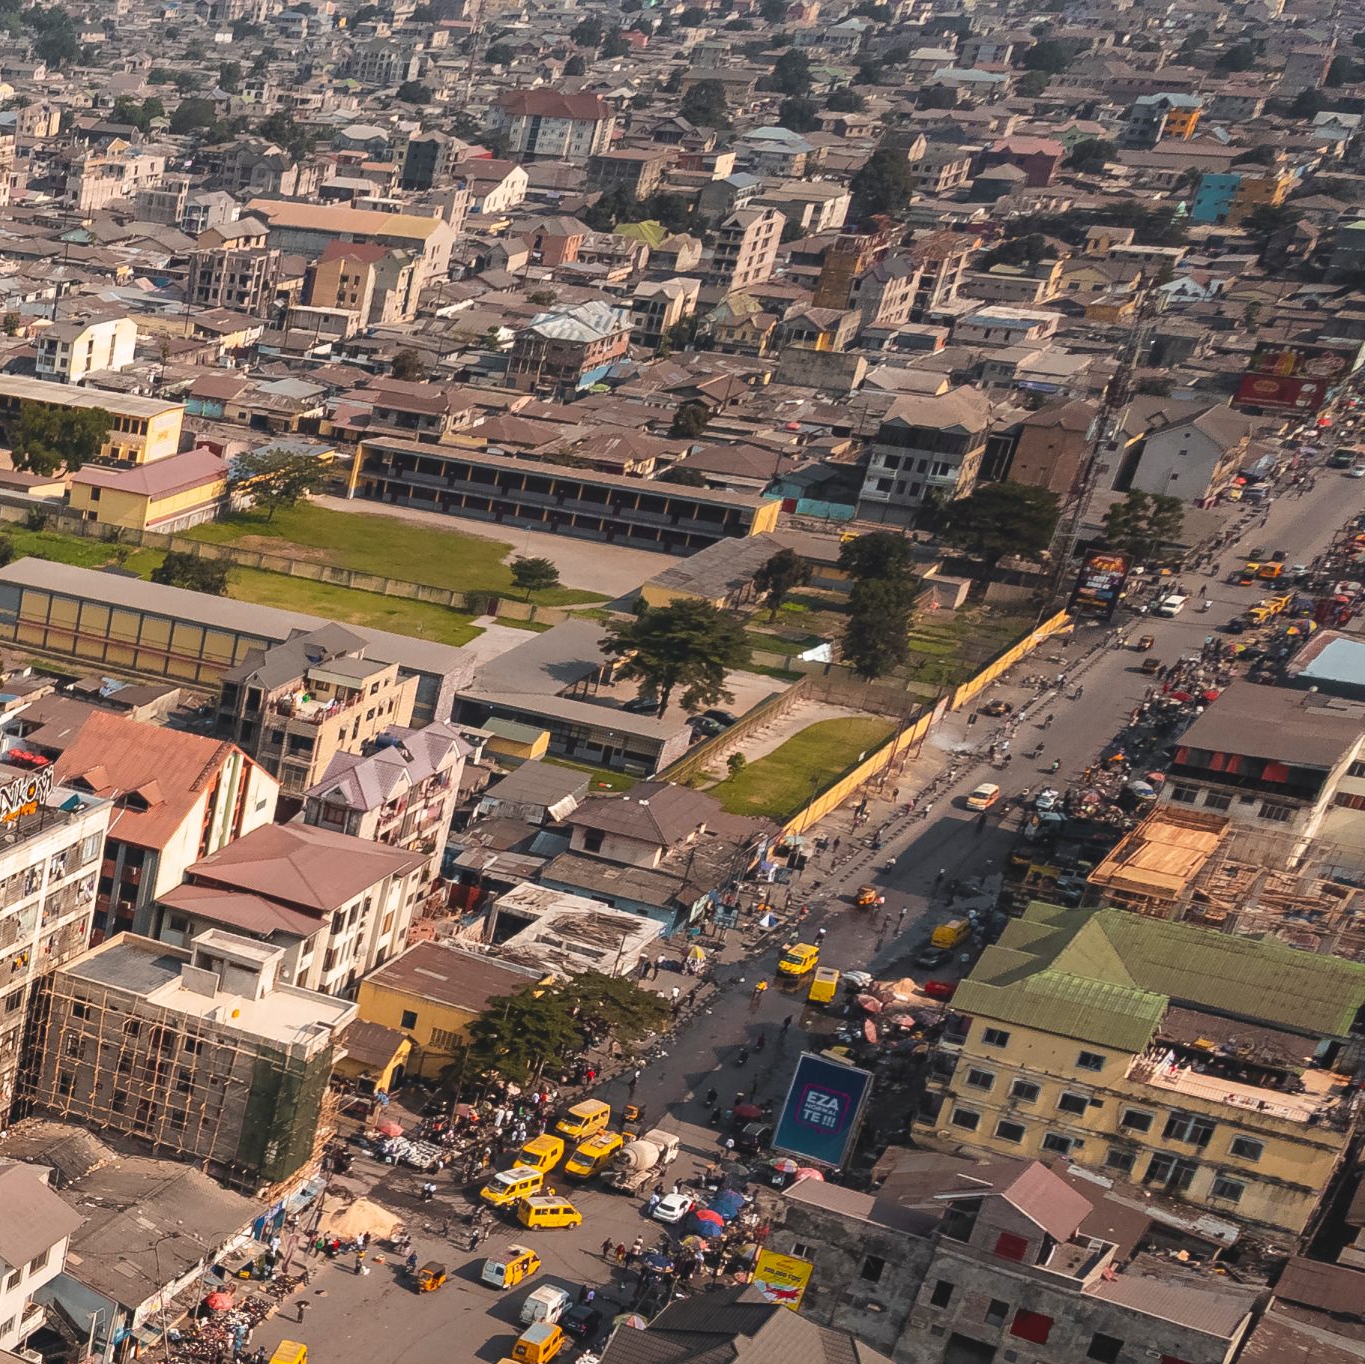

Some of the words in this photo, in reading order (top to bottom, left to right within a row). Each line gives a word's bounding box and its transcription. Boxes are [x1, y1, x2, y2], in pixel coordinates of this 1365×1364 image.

[805, 1101, 837, 1117] NORMAL
[806, 1091, 839, 1112] EZA
[803, 1109, 820, 1124] TE
